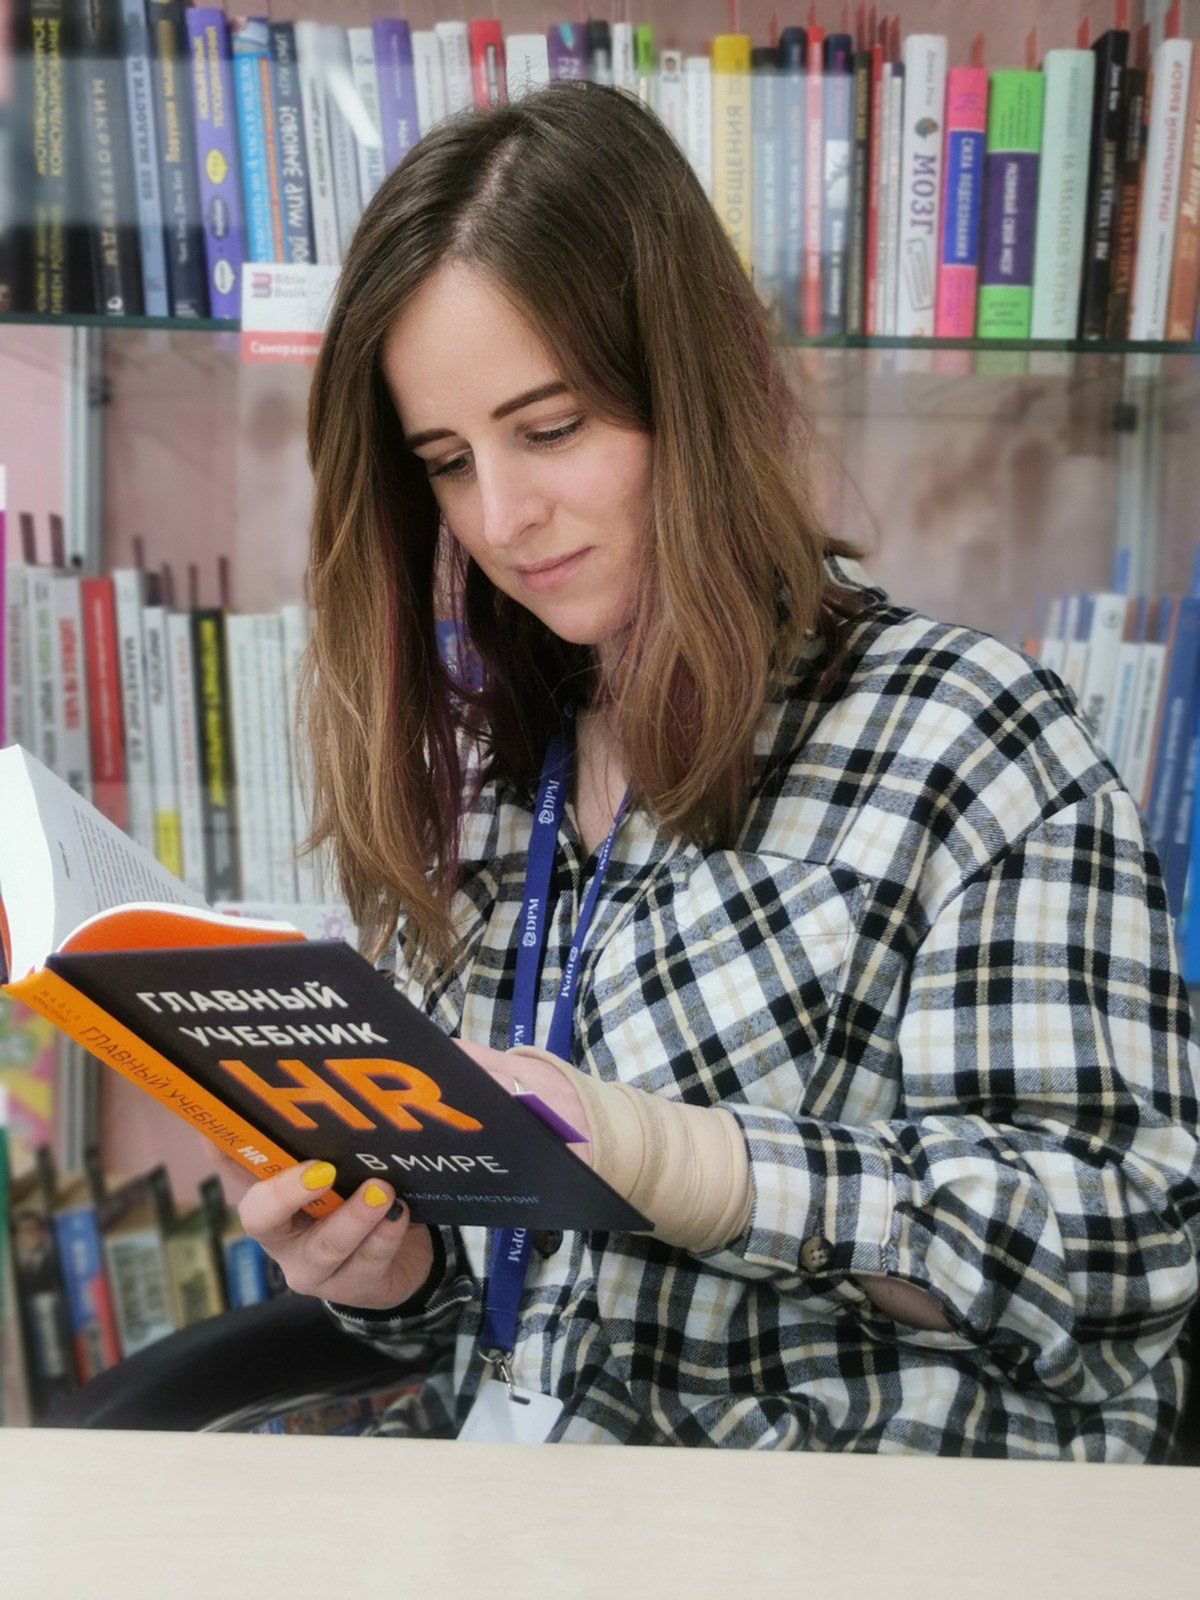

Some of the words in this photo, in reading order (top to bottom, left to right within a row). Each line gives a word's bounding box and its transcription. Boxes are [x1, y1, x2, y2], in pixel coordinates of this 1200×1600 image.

[32, 18, 48, 174] МОТИВАЦИОННОЕ
[48, 18, 62, 175] КОНСУЛЬТИРОВАНИЕ
[1167, 59, 1184, 112] ВЫБОР
[133, 75, 151, 164] ЖАЛОСТИ
[160, 99, 182, 164] Ловушки
[277, 104, 302, 177] ЗАНОВО!
[723, 104, 745, 224] ОБЩЕНИЯ
[959, 137, 975, 169] СИЛА
[1157, 116, 1179, 222] ПРАВИЛЬНЫЙ
[284, 181, 305, 228] МИР
[910, 153, 937, 234] МОЗГ
[953, 173, 973, 257] ПОДСОЗНАНИЯ
[287, 234, 309, 266] РОЙ
[1001, 217, 1017, 244] СВОЙ
[250, 341, 320, 357] Саморазви
[541, 779, 560, 809] DPM
[526, 898, 539, 932] DPM
[136, 980, 349, 1014] ГЛАВНЫЙ
[178, 1022, 389, 1047] УЧЕБНИК
[513, 1024, 525, 1047] PM
[79, 1026, 168, 1091] ГЛАВНЫЙ
[166, 1089, 244, 1147] УЧЕБНИК
[236, 1145, 268, 1167] HR
[218, 1058, 484, 1133] HR
[356, 1153, 389, 1171] В
[391, 1153, 509, 1174] МИРЕ
[508, 1228, 526, 1263] DPM
